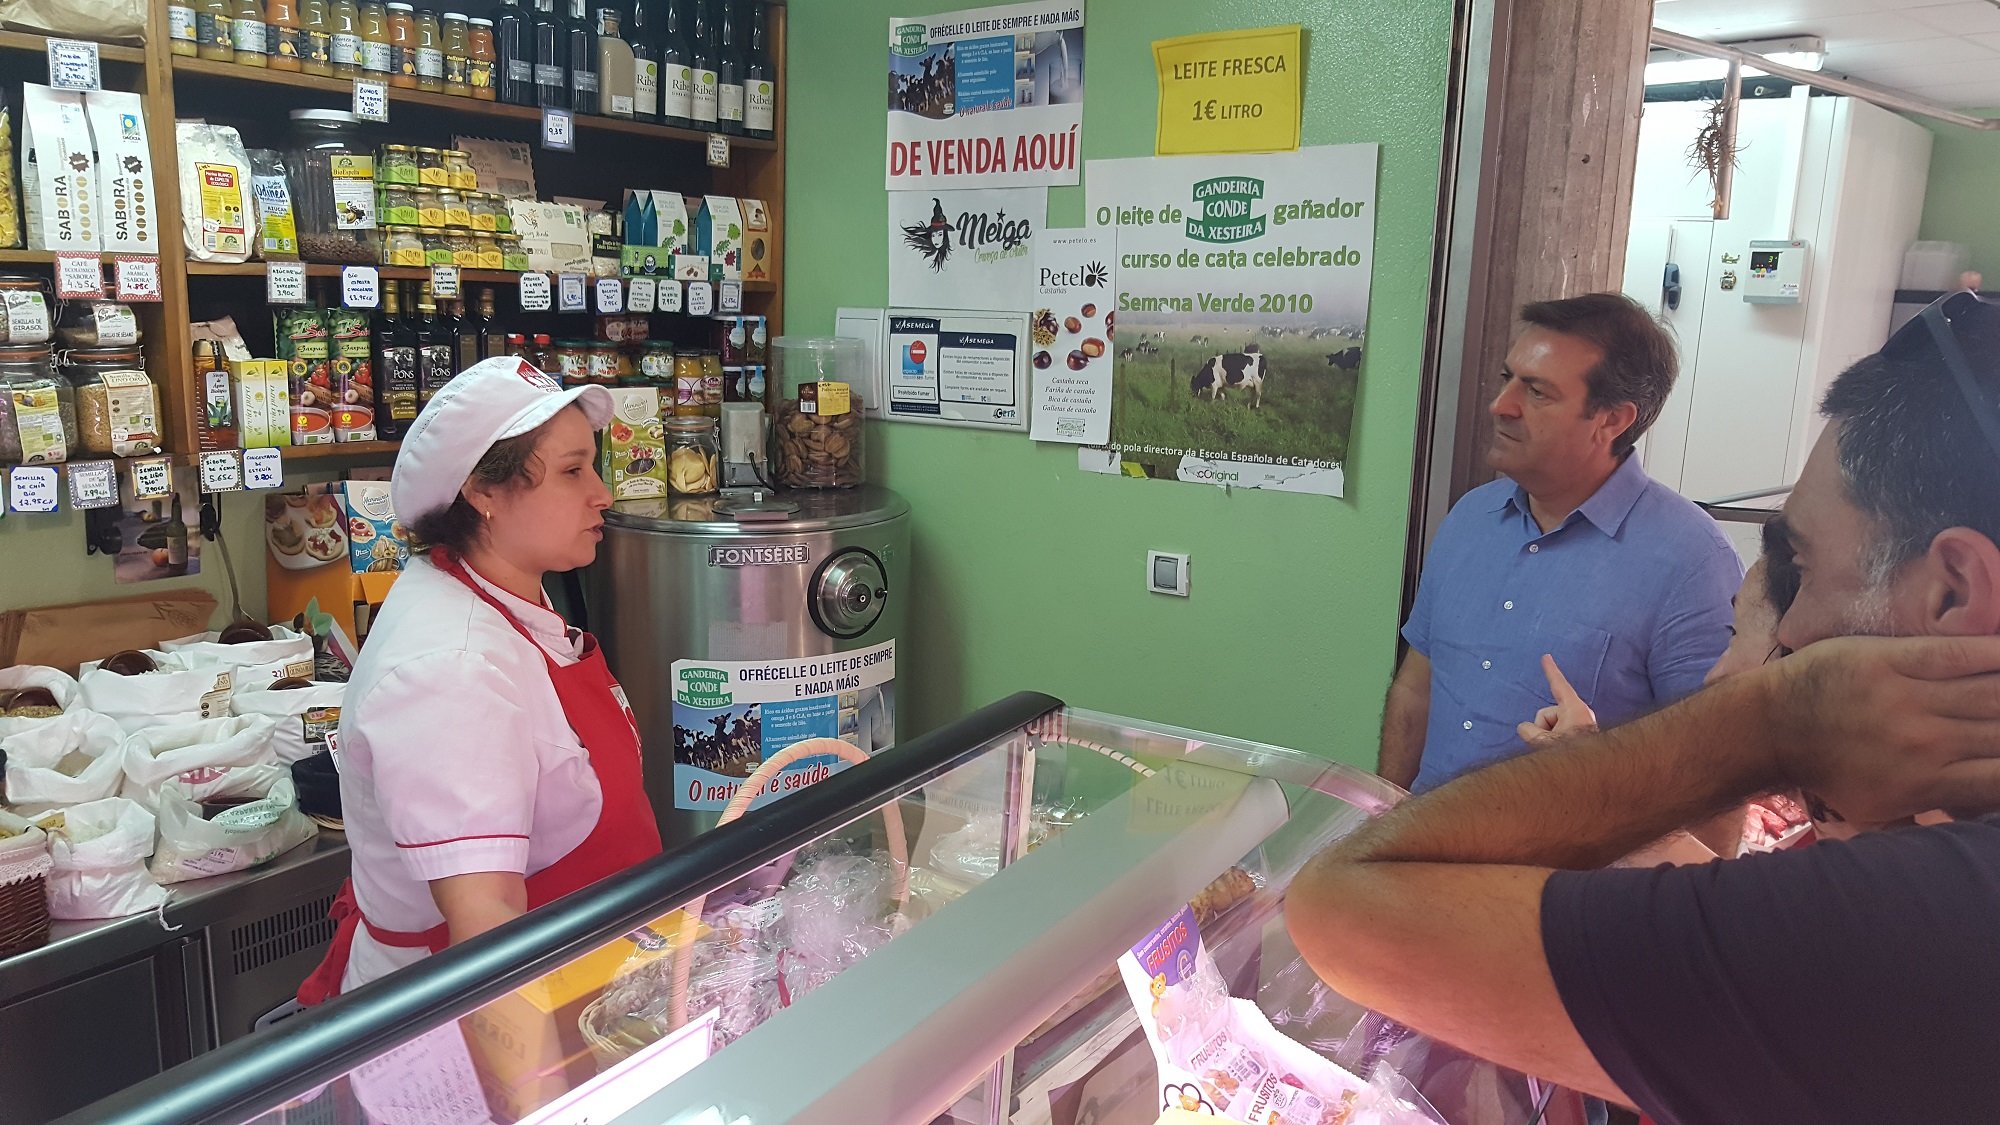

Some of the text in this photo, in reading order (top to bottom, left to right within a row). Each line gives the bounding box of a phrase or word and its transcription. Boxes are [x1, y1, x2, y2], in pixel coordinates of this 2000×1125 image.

[930, 8, 1080, 38] OFRÉCELLE O LEITE DE SEMPRE E NADA MÁIS
[1174, 55, 1286, 80] LEITE FRESCA
[1192, 99, 1262, 121] 1€ LITRO
[890, 141, 922, 176] DE
[927, 136, 1006, 175] VENDA
[1195, 180, 1260, 199] GANDEIRÍA
[54, 175, 71, 240] SABORA
[112, 176, 128, 240] SABORA
[1096, 197, 1364, 226] O leite de gañador
[1206, 199, 1248, 218] CONDE
[956, 208, 1032, 250] Meiga
[1188, 222, 1262, 240] DA XESTEIRA
[1121, 246, 1361, 270] curso de cata celebrado
[1118, 292, 1313, 314] Semana Verde 2010
[394, 369, 414, 379] PONS
[431, 368, 450, 377] PONS
[1124, 443, 1142, 453] pola
[1144, 444, 1182, 456] directora
[1186, 448, 1196, 457] da
[1200, 448, 1228, 460] Escola
[1232, 452, 1272, 464] Española
[1276, 456, 1288, 464] de
[682, 670, 726, 681] GANDEIRÍA
[740, 648, 892, 681] OFRÉCELLE O LEITE DE SEMPRE
[690, 682, 718, 692] CONDE
[795, 675, 860, 696] E NADA MÁIS
[679, 694, 730, 706] DA XESTEIRA
[688, 780, 702, 802] O
[770, 772, 782, 792] é
[784, 762, 829, 791] saúde
[1146, 921, 1187, 974] FRUSITOS
[1191, 1031, 1227, 1070] FRUSITOS
[1248, 1073, 1278, 1121] FRUSITOS
